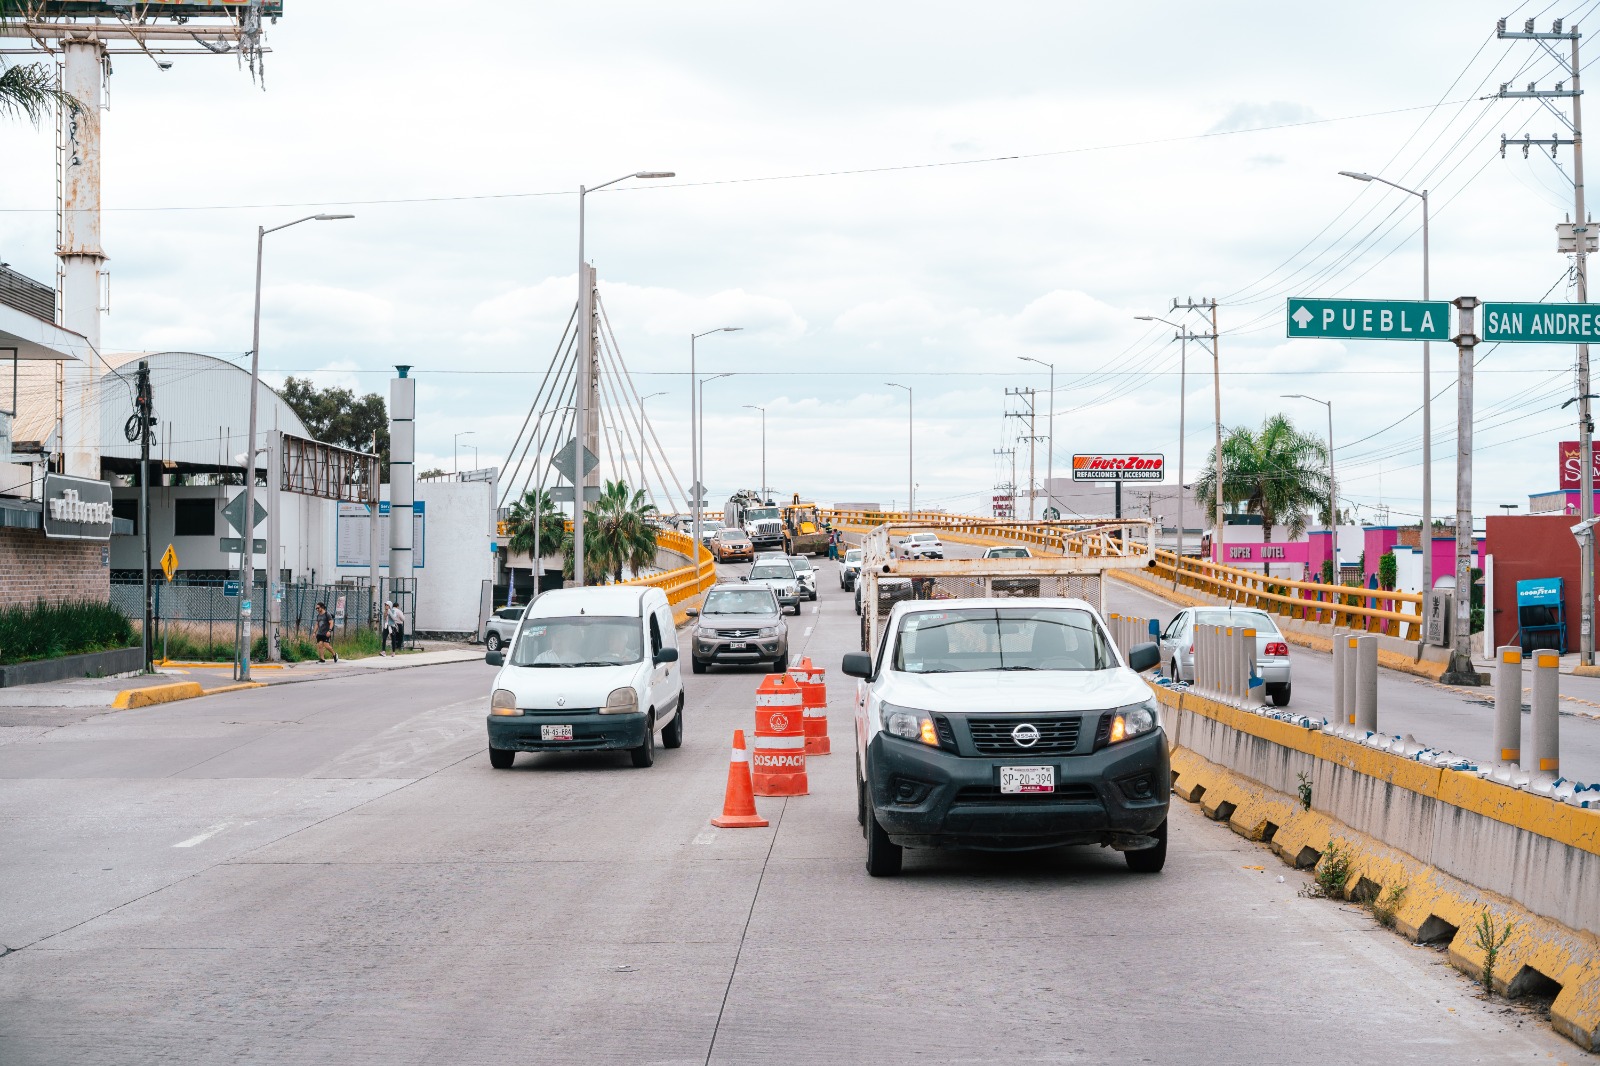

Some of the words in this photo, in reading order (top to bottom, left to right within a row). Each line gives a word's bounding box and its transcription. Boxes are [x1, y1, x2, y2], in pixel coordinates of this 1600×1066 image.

[1322, 308, 1435, 332] PUEBLA
[1488, 311, 1523, 334] SAN
[1530, 313, 1600, 335] ANDRES
[1089, 457, 1162, 469] AutoZone
[1230, 547, 1250, 558] SUPER
[1261, 546, 1284, 558] MOTEL
[1519, 588, 1557, 597] GOODYEAR
[754, 755, 803, 766] SOSAPACH
[1003, 773, 1051, 785] SP-20-394
